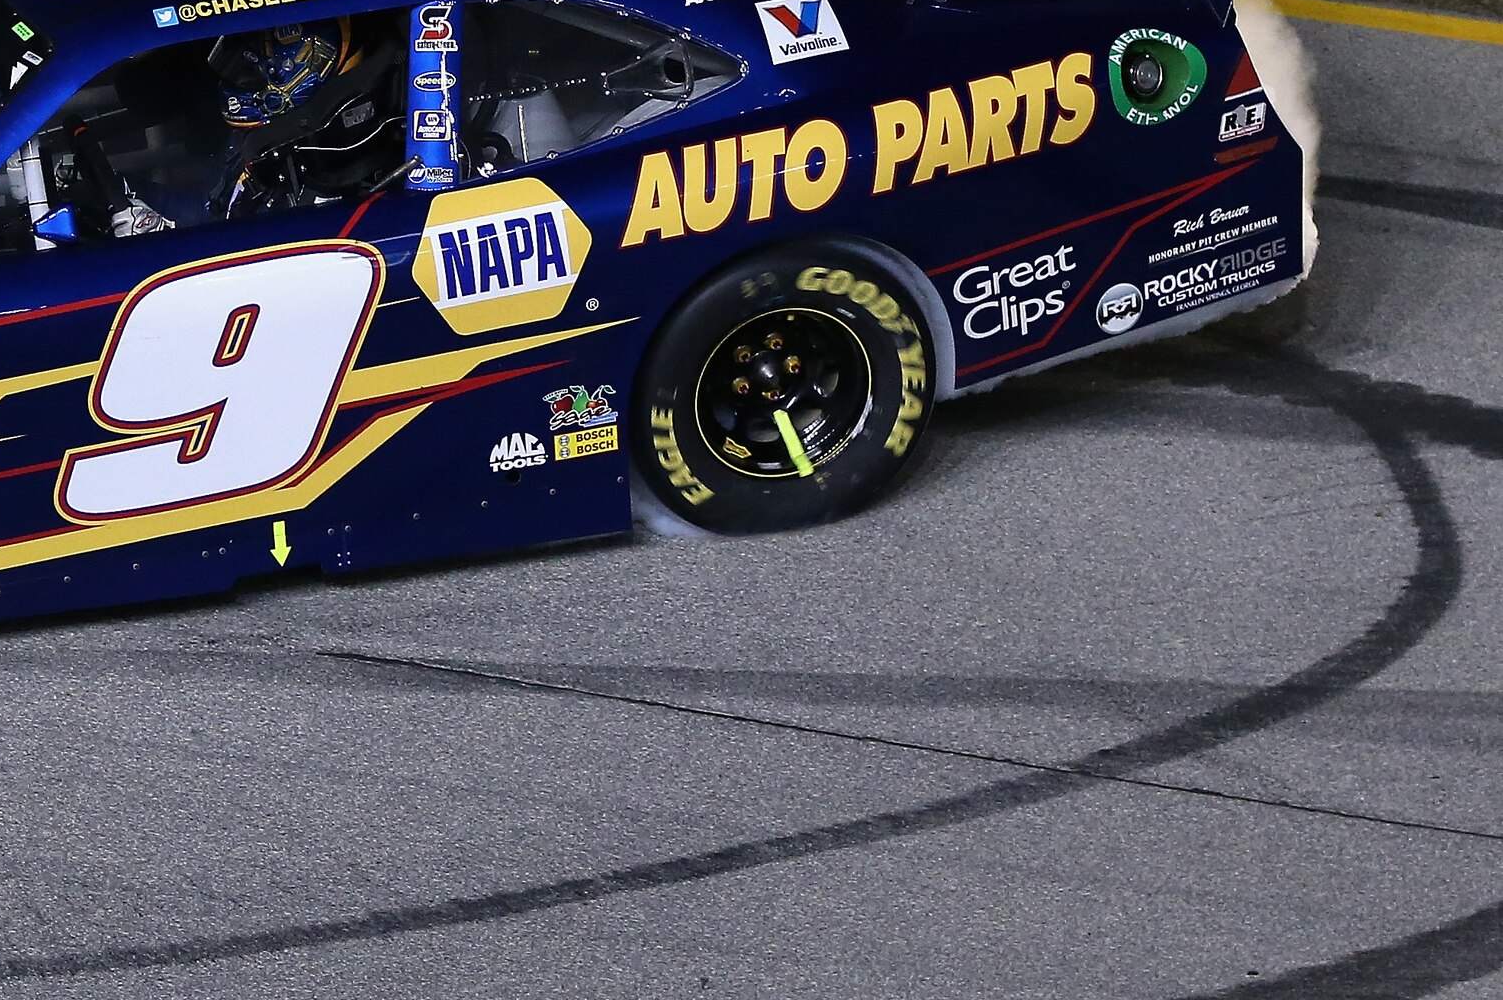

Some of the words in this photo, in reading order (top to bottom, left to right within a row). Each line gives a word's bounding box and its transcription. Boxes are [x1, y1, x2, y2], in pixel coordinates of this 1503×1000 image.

[779, 36, 837, 56] Valvoline
[1109, 28, 1188, 66] AMERICAN
[620, 119, 847, 248] AUTO
[872, 52, 1096, 194] PARTS
[1149, 241, 1196, 264] HONORARY
[1198, 236, 1213, 249] PIT
[1215, 228, 1239, 243] CREW
[1241, 216, 1278, 235] MEMBER
[1173, 214, 1204, 237] Rich
[438, 212, 566, 299] NAPA
[953, 245, 1076, 304] Great
[1158, 278, 1217, 307] CUSTOM
[1220, 260, 1276, 286] TRUCKS
[964, 290, 1065, 339] Clips
[57, 242, 383, 523] 9
[490, 433, 545, 463] MAC
[576, 428, 613, 442] BOSCH
[577, 440, 614, 454] BOSCH
[490, 455, 546, 472] TOOLS
